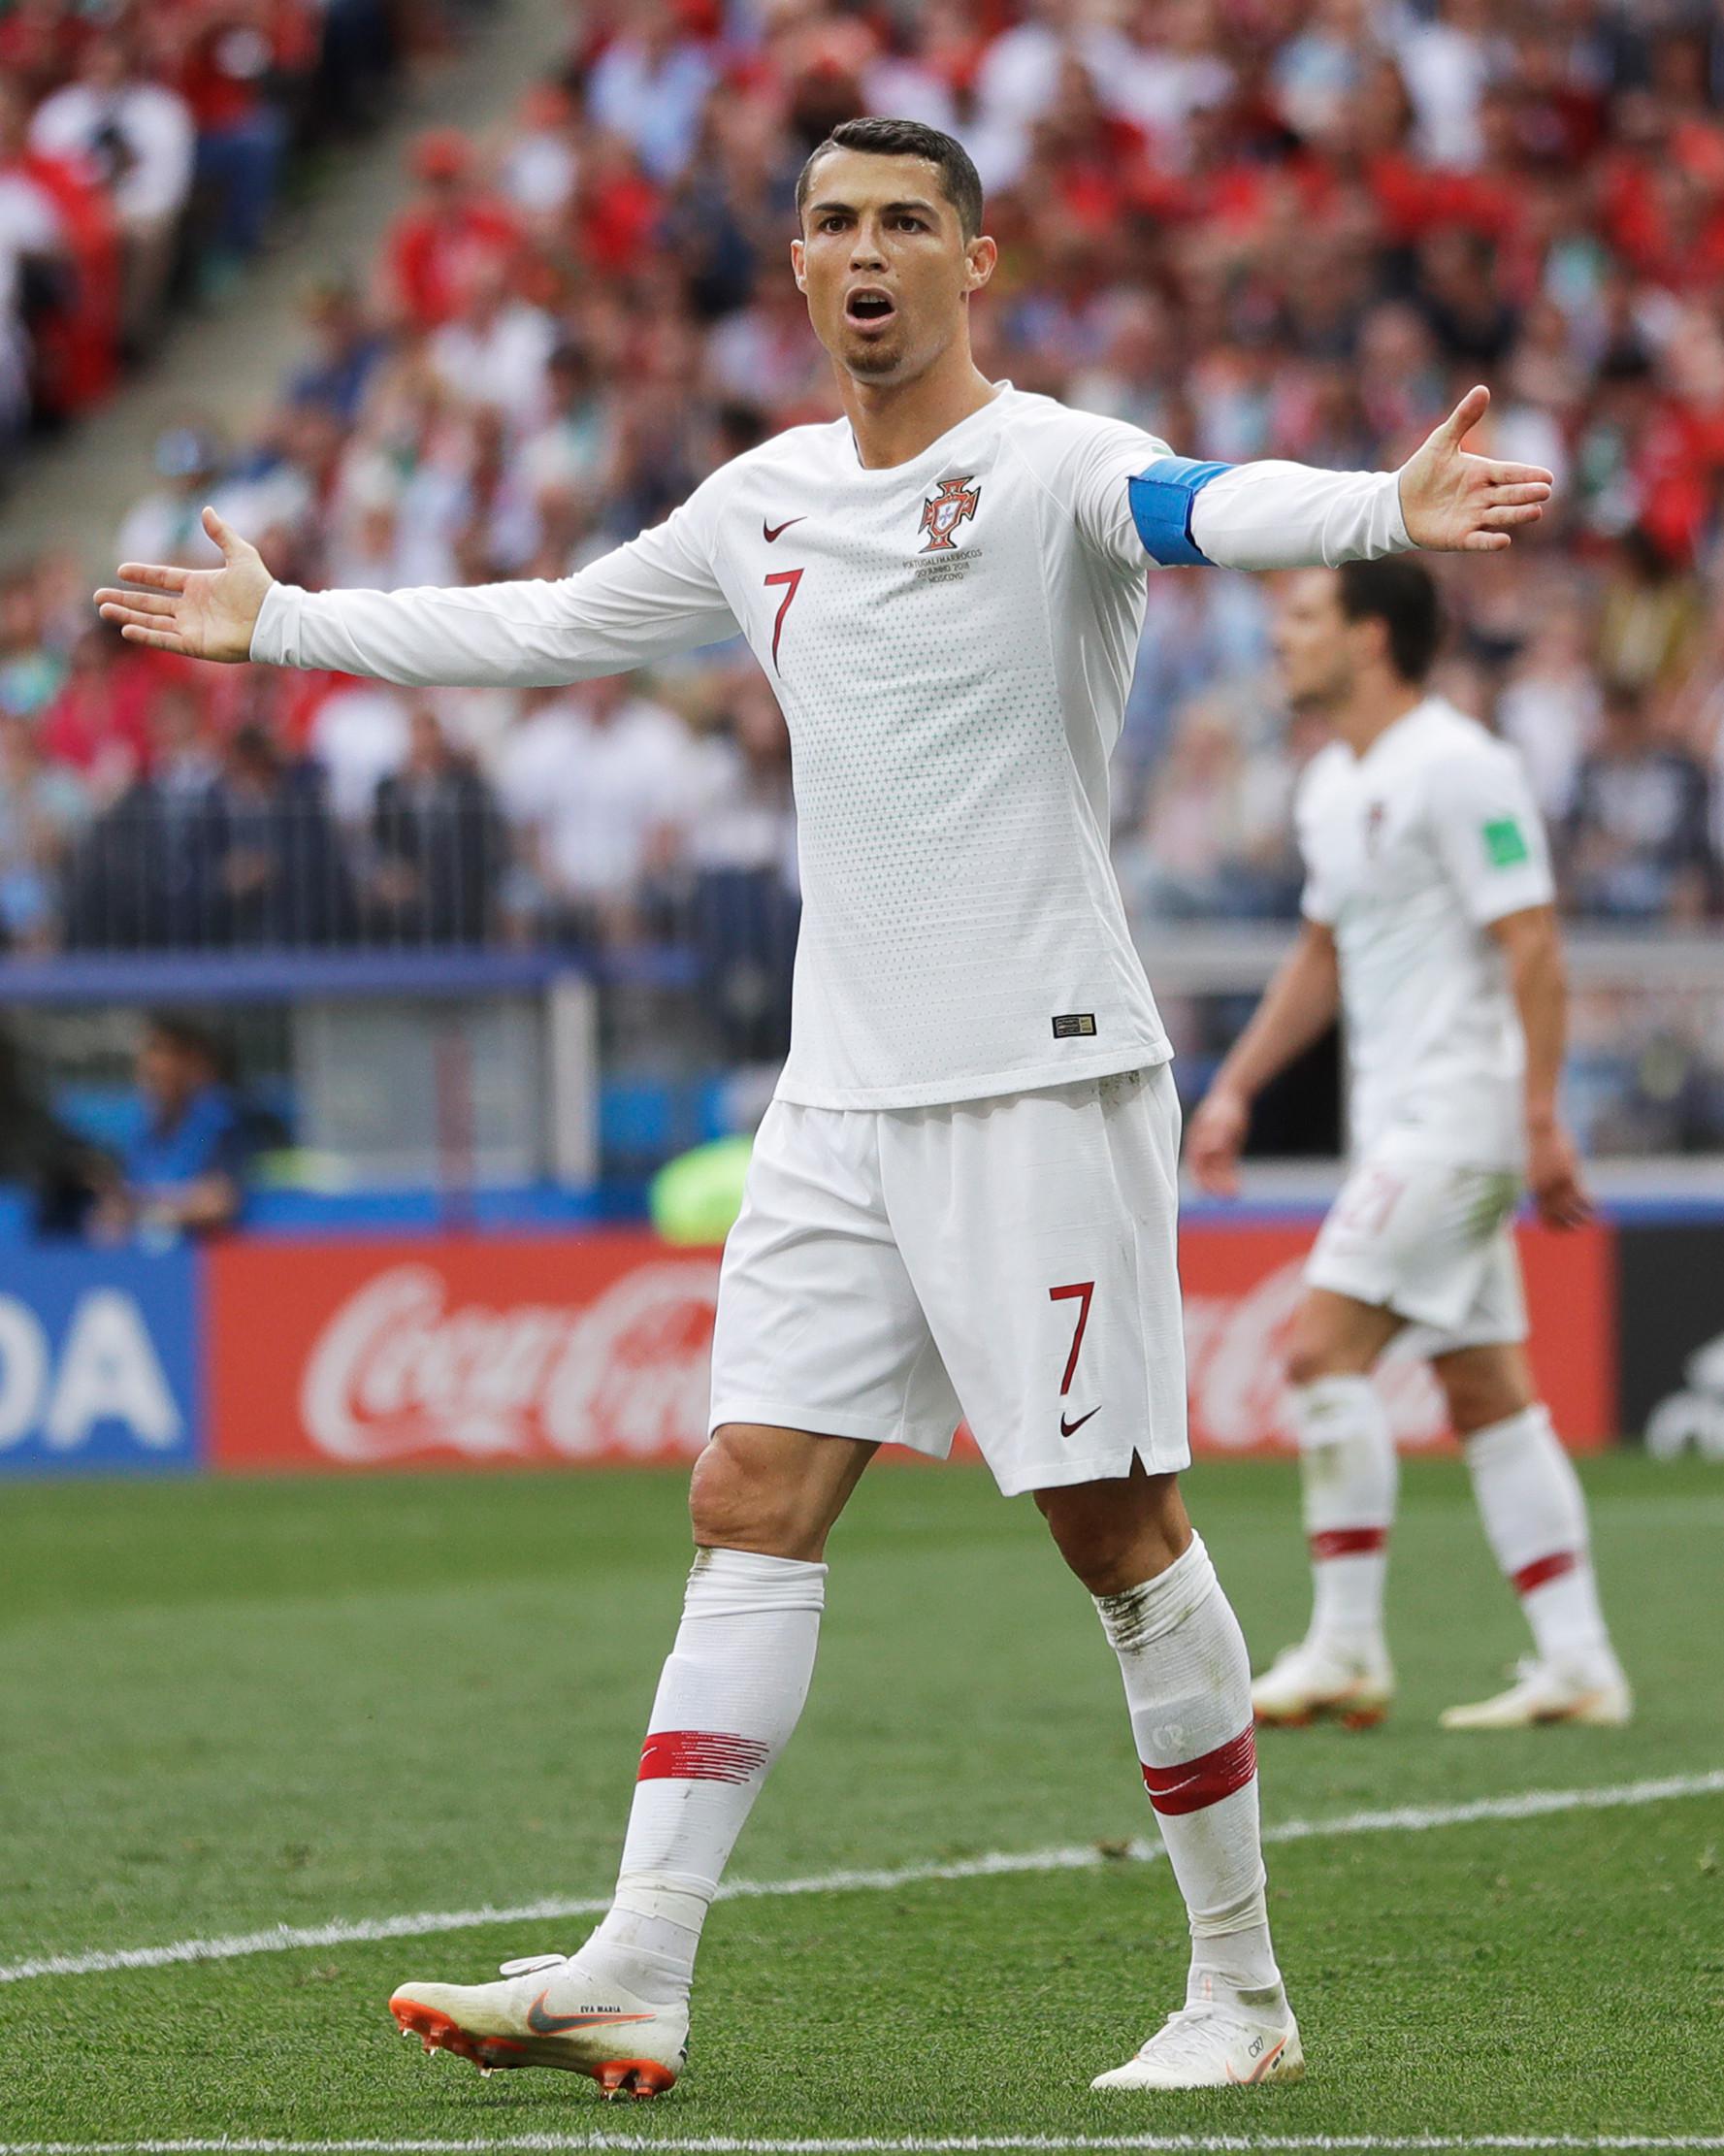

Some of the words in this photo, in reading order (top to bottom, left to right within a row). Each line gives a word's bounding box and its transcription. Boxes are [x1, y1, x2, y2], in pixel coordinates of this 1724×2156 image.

[764, 568, 804, 678] 7
[1049, 1281, 1095, 1396] 7
[1249, 2036, 1264, 2058] CR7
